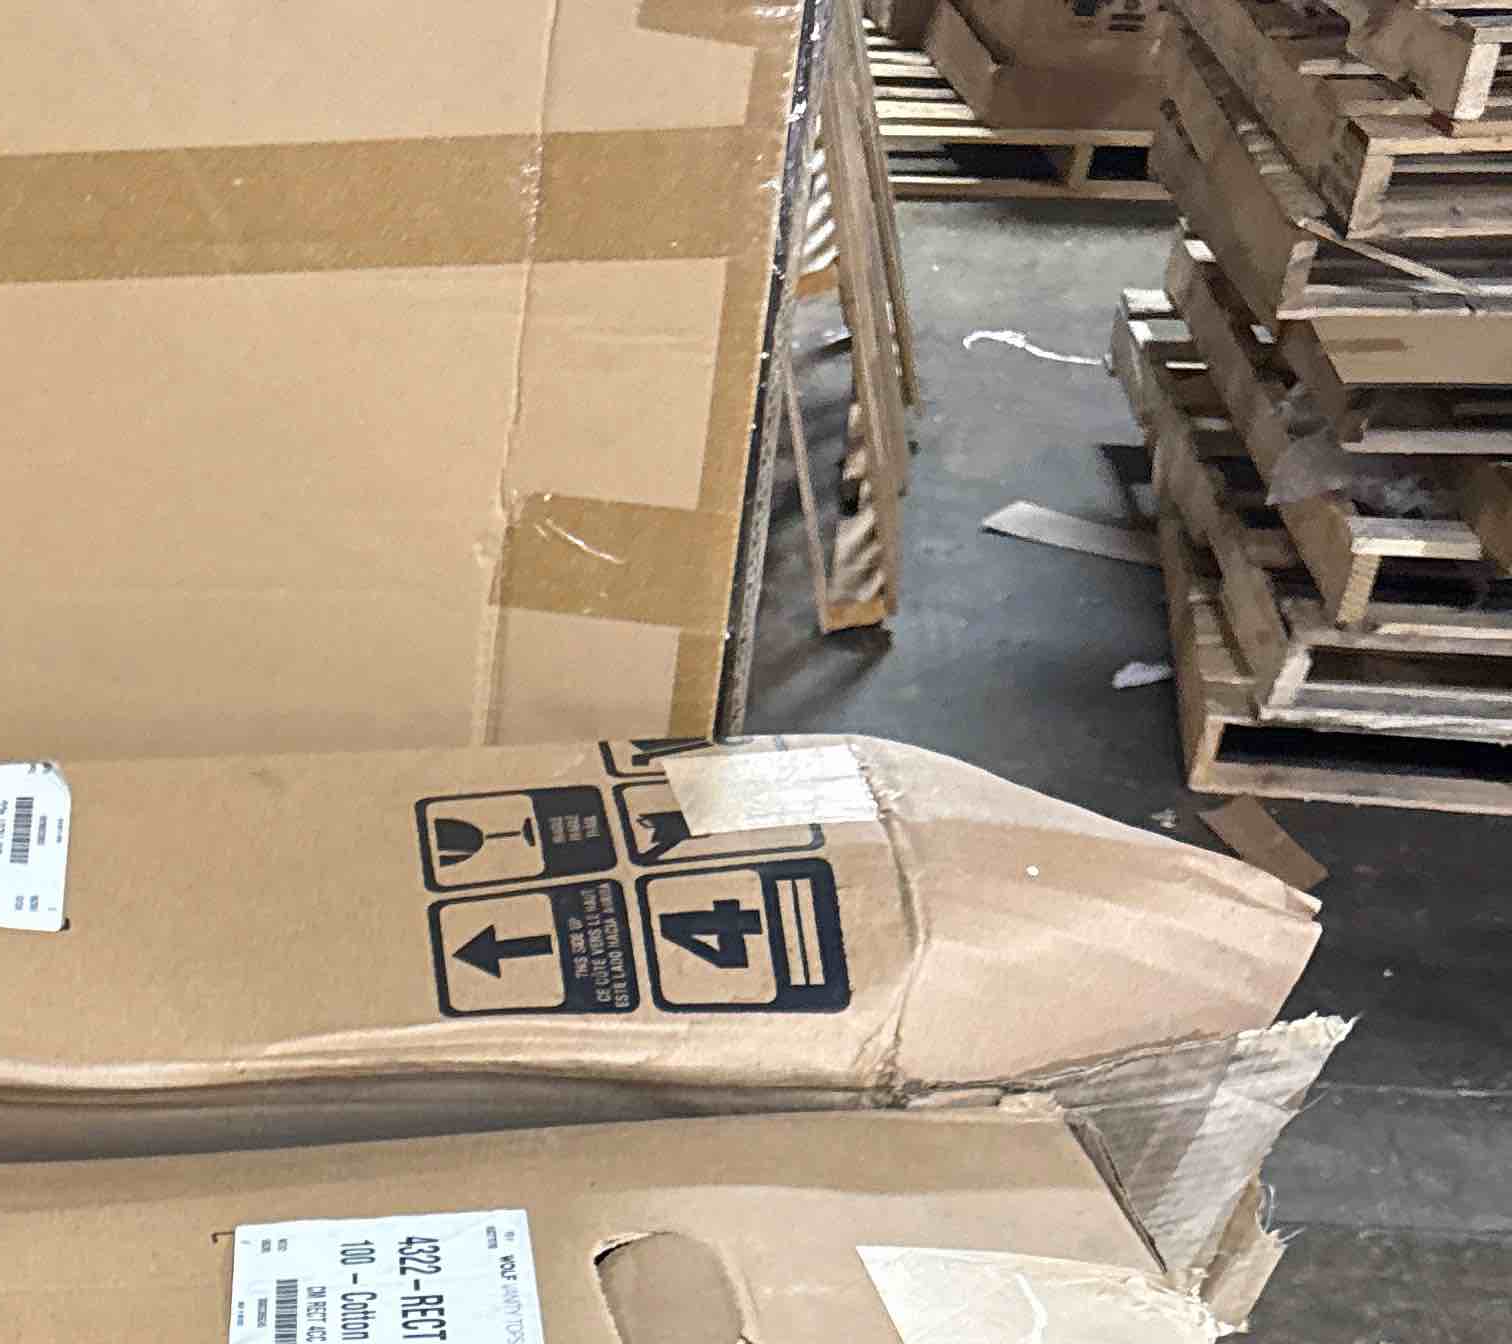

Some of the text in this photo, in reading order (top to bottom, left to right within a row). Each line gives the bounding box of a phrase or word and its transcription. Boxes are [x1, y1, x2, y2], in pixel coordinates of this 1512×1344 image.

[659, 899, 765, 970] 4
[340, 1239, 375, 1265] 100
[398, 1236, 442, 1276] 4322
[500, 1254, 517, 1281] WOLF
[306, 1301, 327, 1323] RECT
[341, 1291, 377, 1340] Cotton
[400, 1294, 447, 1341] RECT
[306, 1325, 327, 1343] 4CC
